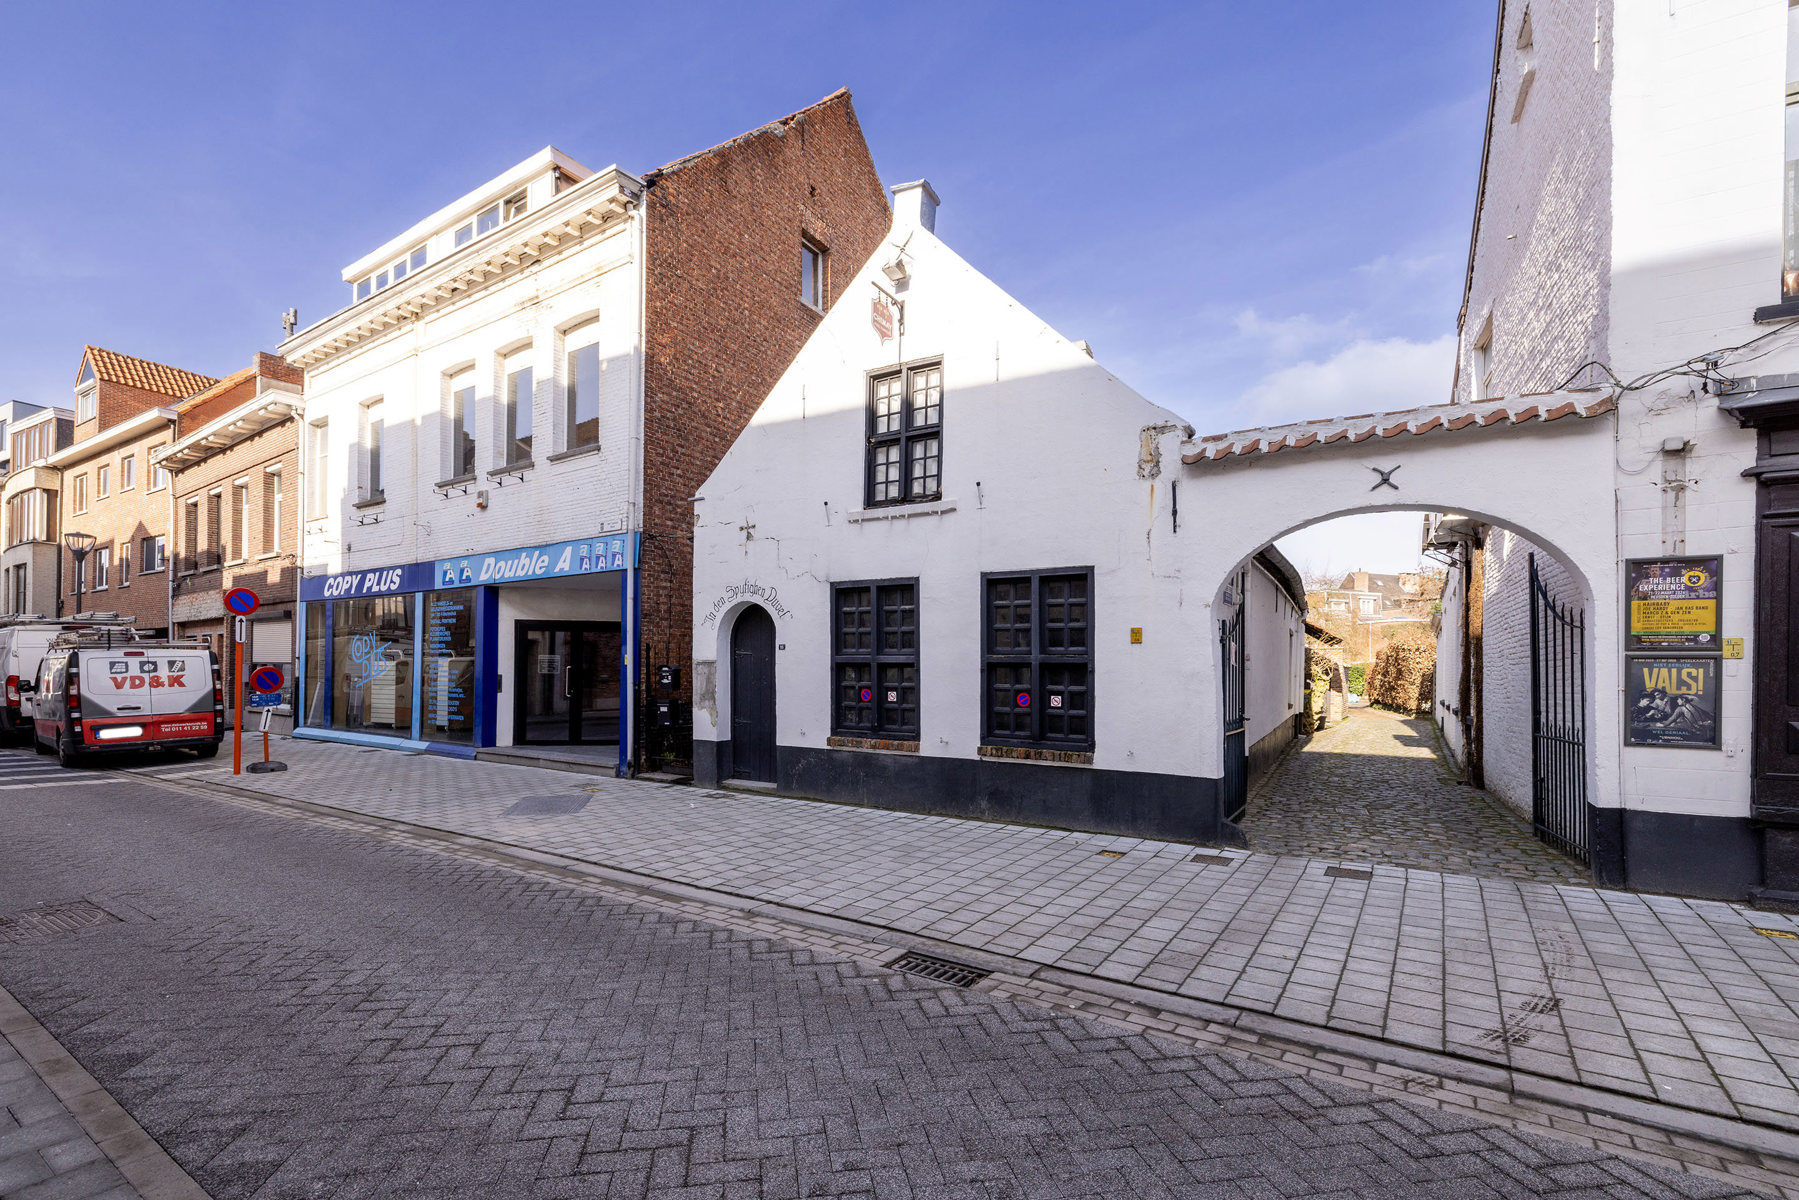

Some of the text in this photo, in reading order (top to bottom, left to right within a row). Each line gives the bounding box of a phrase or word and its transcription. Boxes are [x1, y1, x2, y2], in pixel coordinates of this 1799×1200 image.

[478, 545, 573, 581] Double A
[581, 558, 591, 571] A
[597, 557, 607, 570] A
[613, 554, 623, 568] A
[445, 569, 455, 582] A
[462, 567, 472, 580] A
[1666, 576, 1686, 584] BEER
[323, 568, 402, 597] COPY PLUS
[1639, 583, 1686, 592] EXPERIENCE
[713, 596, 727, 613] den
[109, 674, 187, 690] VD&K
[1643, 667, 1704, 695] VALS!
